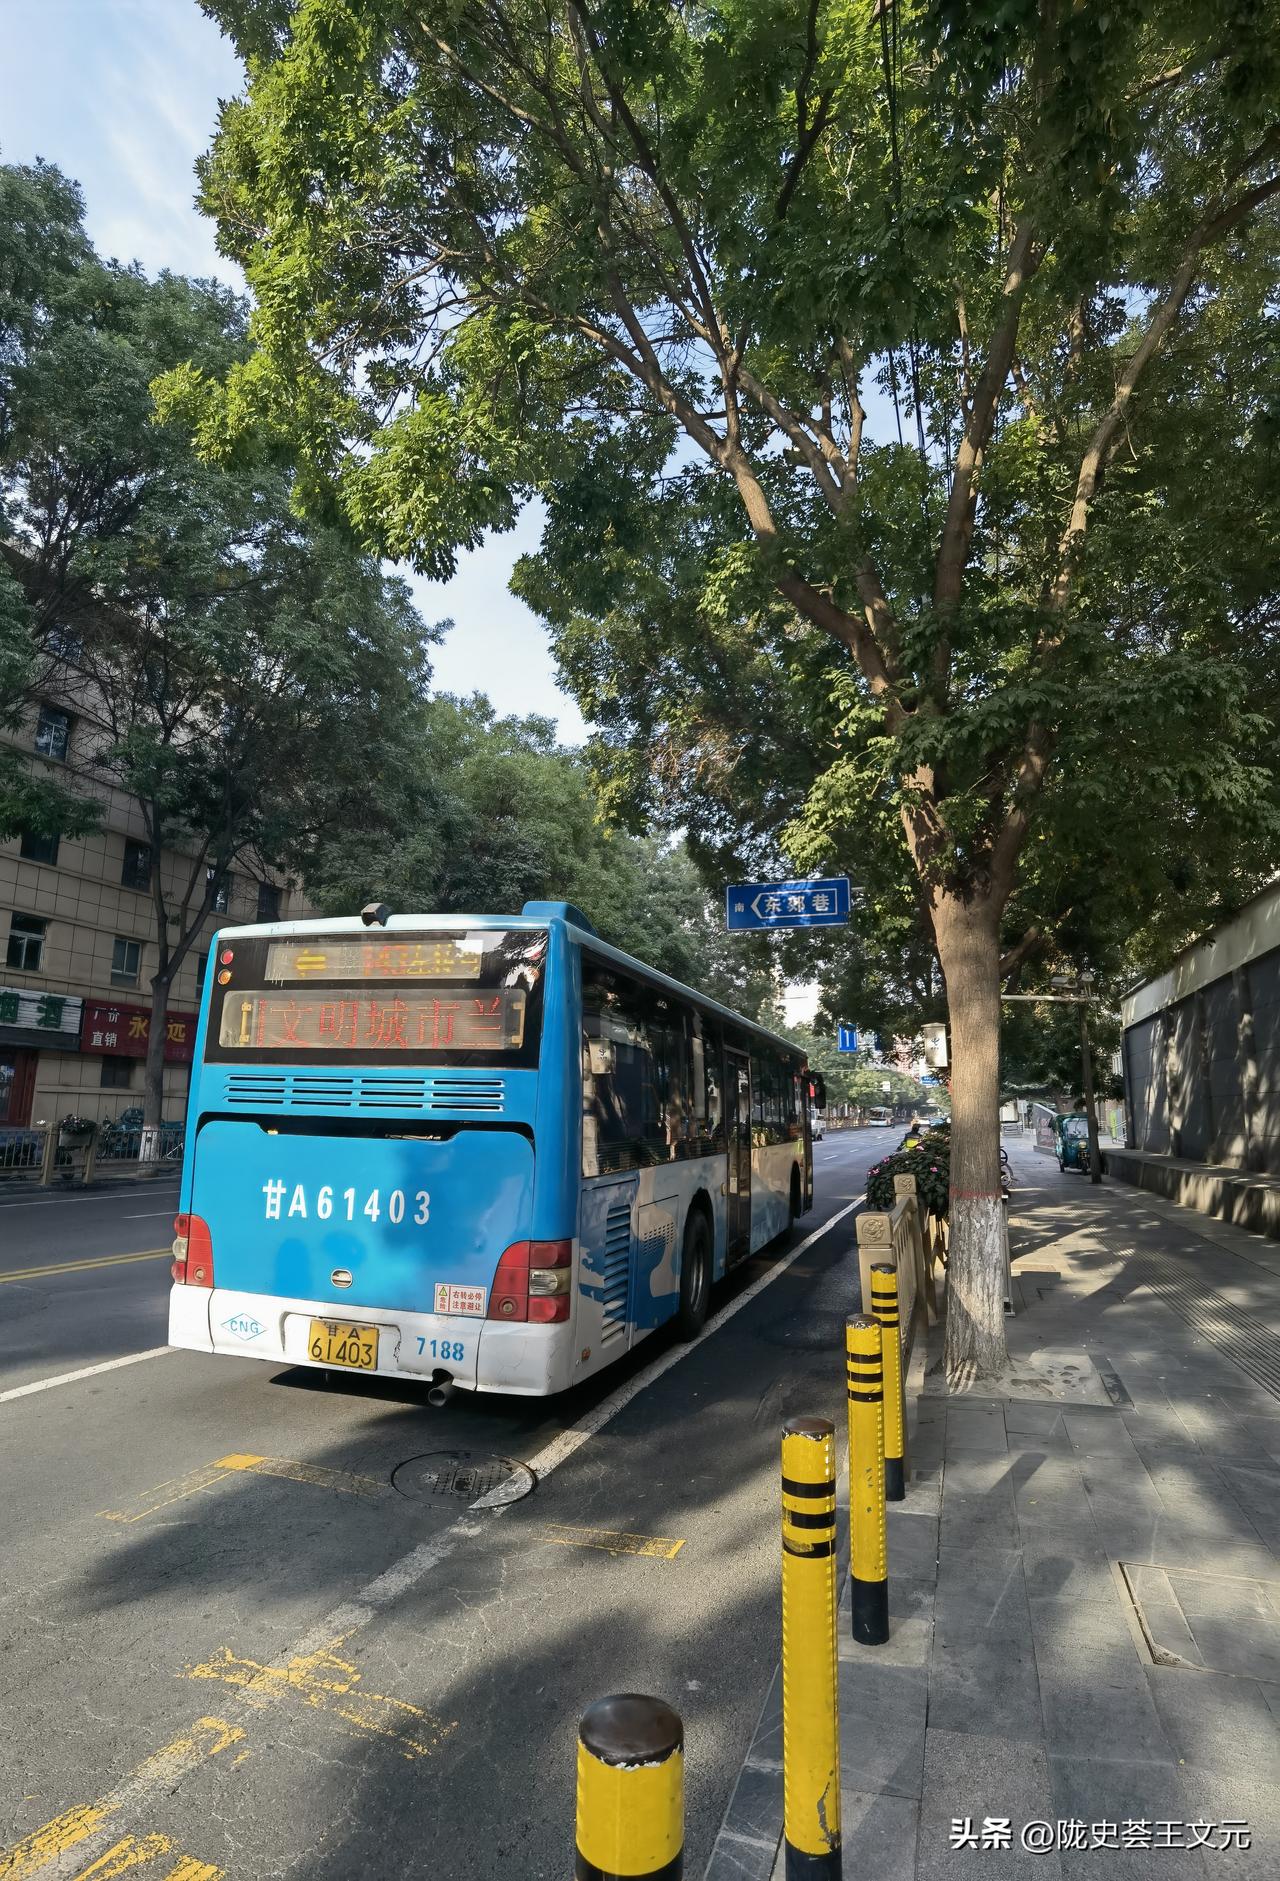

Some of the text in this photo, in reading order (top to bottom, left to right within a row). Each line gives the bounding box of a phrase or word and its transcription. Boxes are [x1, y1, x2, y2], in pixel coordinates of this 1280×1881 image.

[734, 902, 745, 913] 南
[764, 894, 830, 913] 东郊巷
[93, 1007, 120, 1023] 厂价
[257, 997, 502, 1049] 文明城市兰
[91, 1031, 118, 1048] 直销
[262, 1179, 431, 1225] 甘A61403
[230, 1321, 260, 1335] CNG
[311, 1338, 374, 1366] 61403
[416, 1337, 465, 1361] 7188
